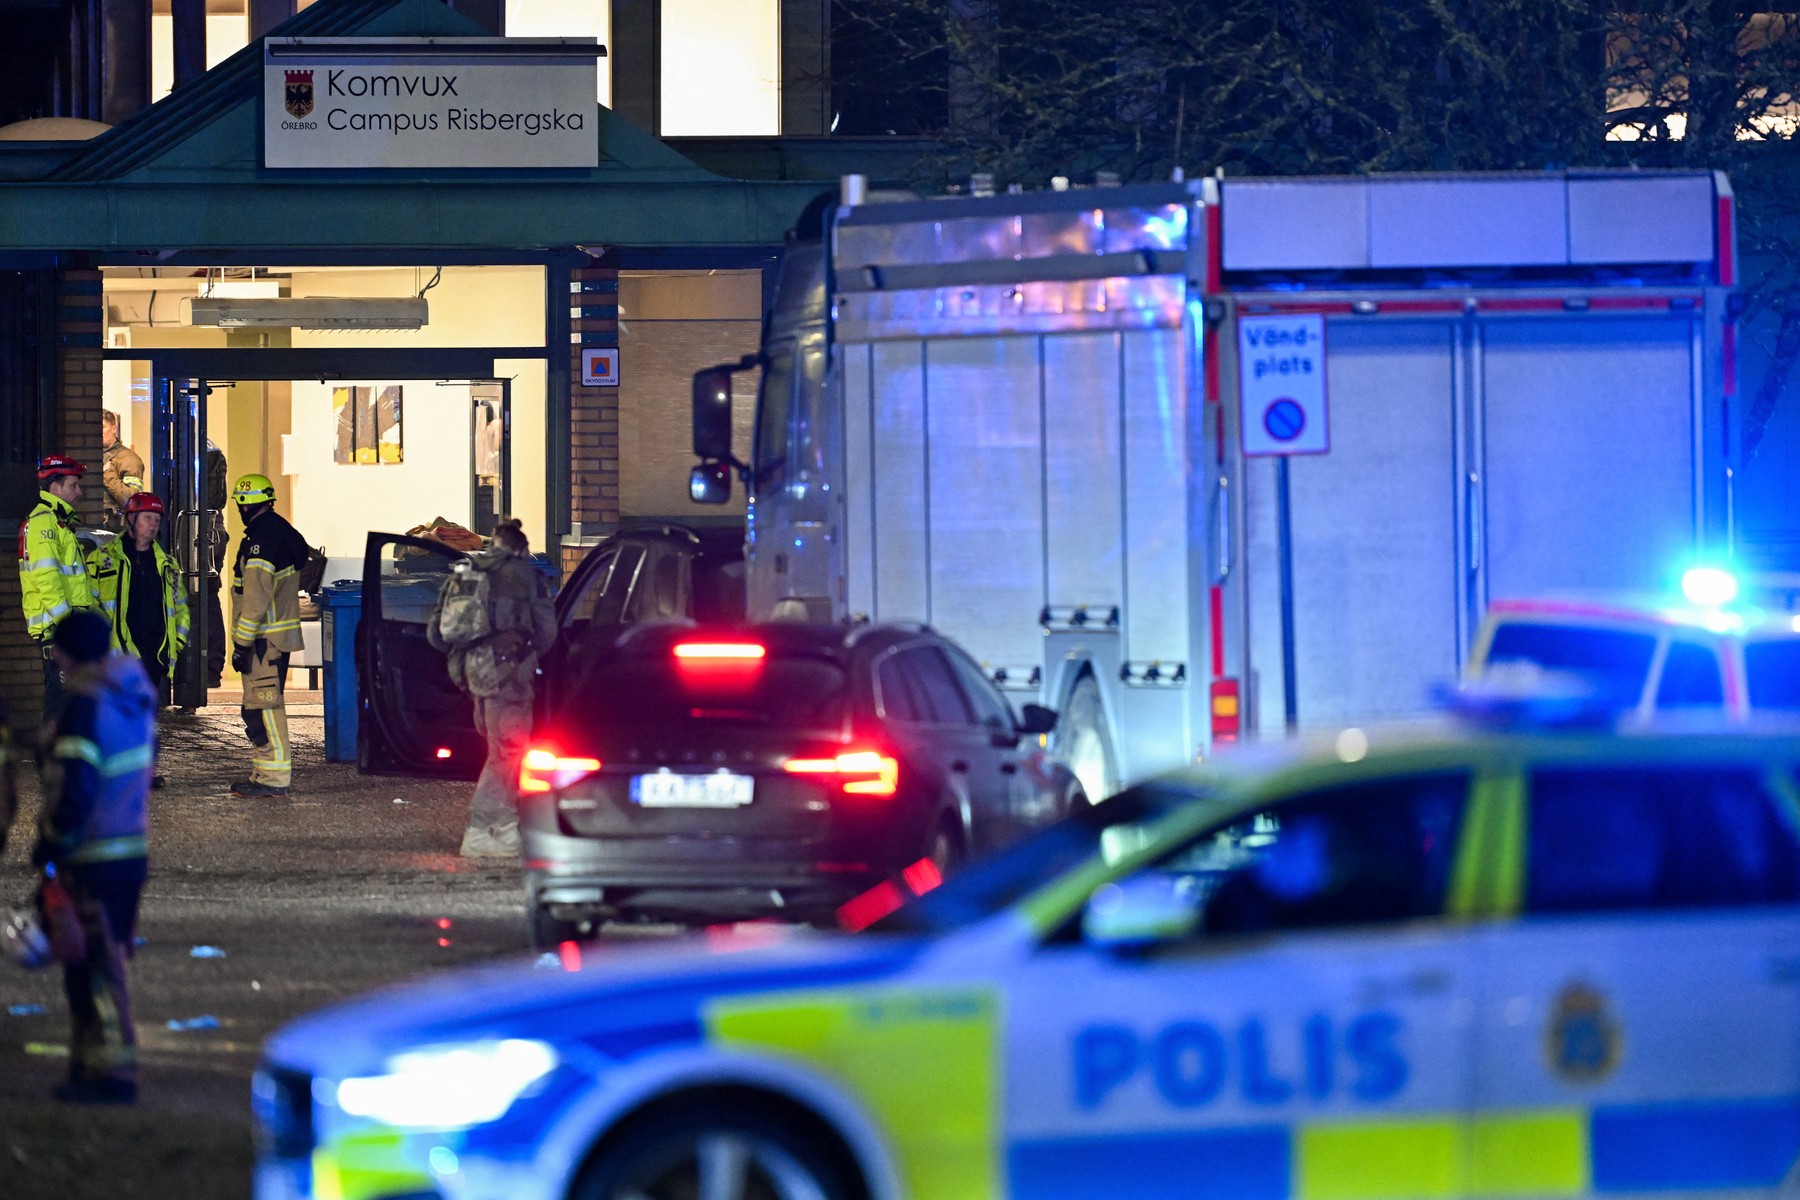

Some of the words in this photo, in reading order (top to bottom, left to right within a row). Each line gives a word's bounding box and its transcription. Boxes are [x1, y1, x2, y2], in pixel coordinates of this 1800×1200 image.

[328, 69, 458, 97] Komvux
[281, 120, 318, 130] ÖREBRO
[327, 108, 438, 135] Campus
[447, 108, 583, 136] Risbergska
[1253, 353, 1313, 380] plats
[239, 481, 251, 491] 98
[257, 690, 273, 701] 98
[1071, 1008, 1411, 1112] POLIS
